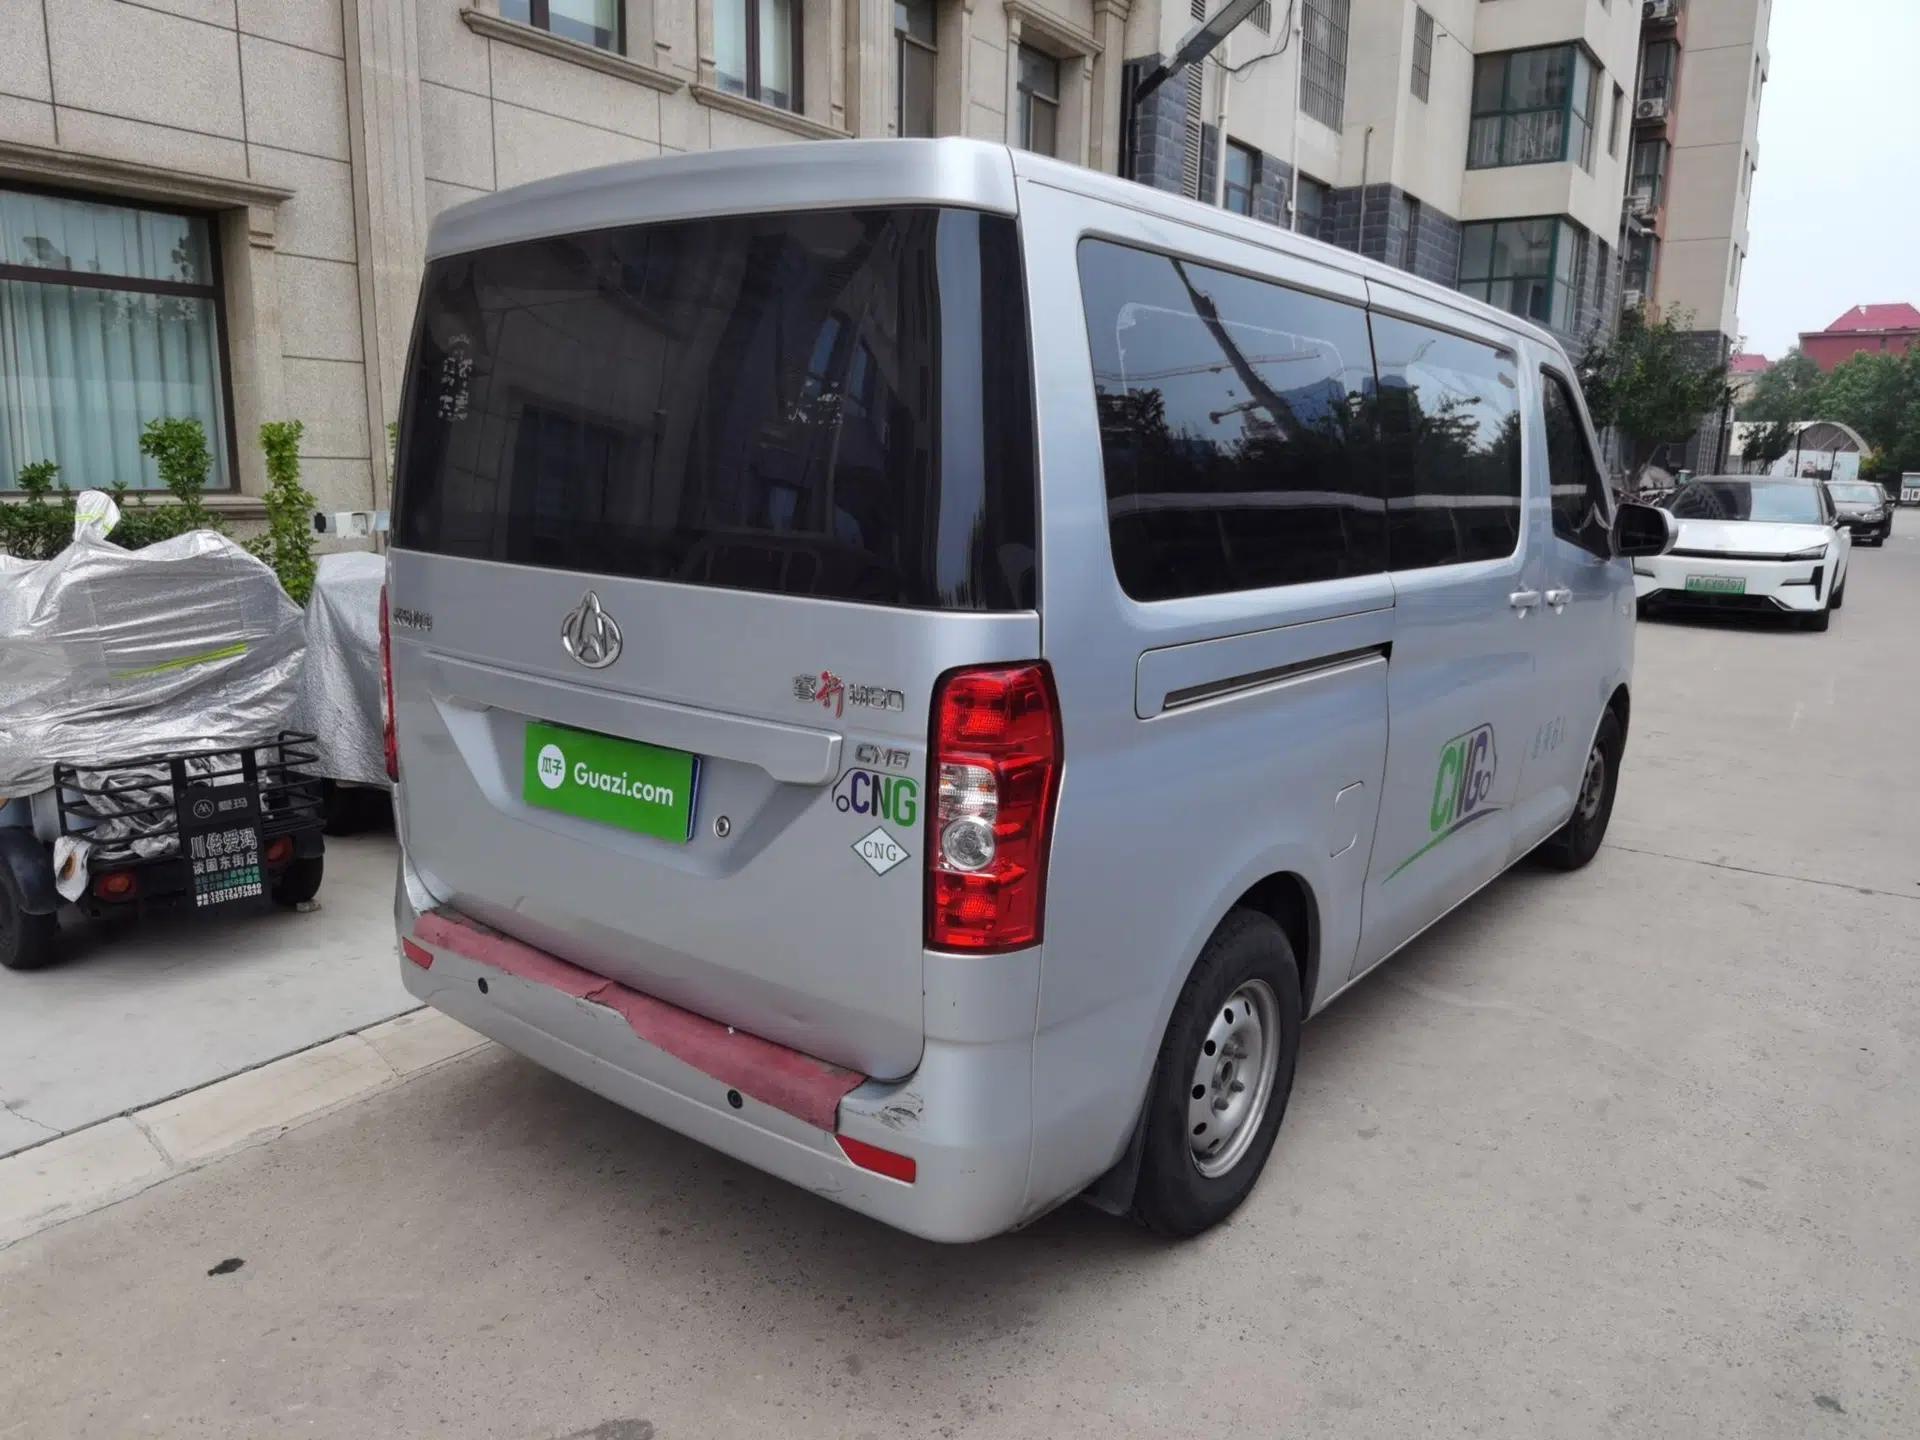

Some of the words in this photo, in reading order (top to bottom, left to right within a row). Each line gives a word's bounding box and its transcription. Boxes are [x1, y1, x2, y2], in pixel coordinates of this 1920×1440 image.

[541, 756, 563, 777] 瓜子
[574, 762, 674, 807] Guazi.com
[851, 771, 917, 827] CNG
[863, 840, 897, 862] CNG
